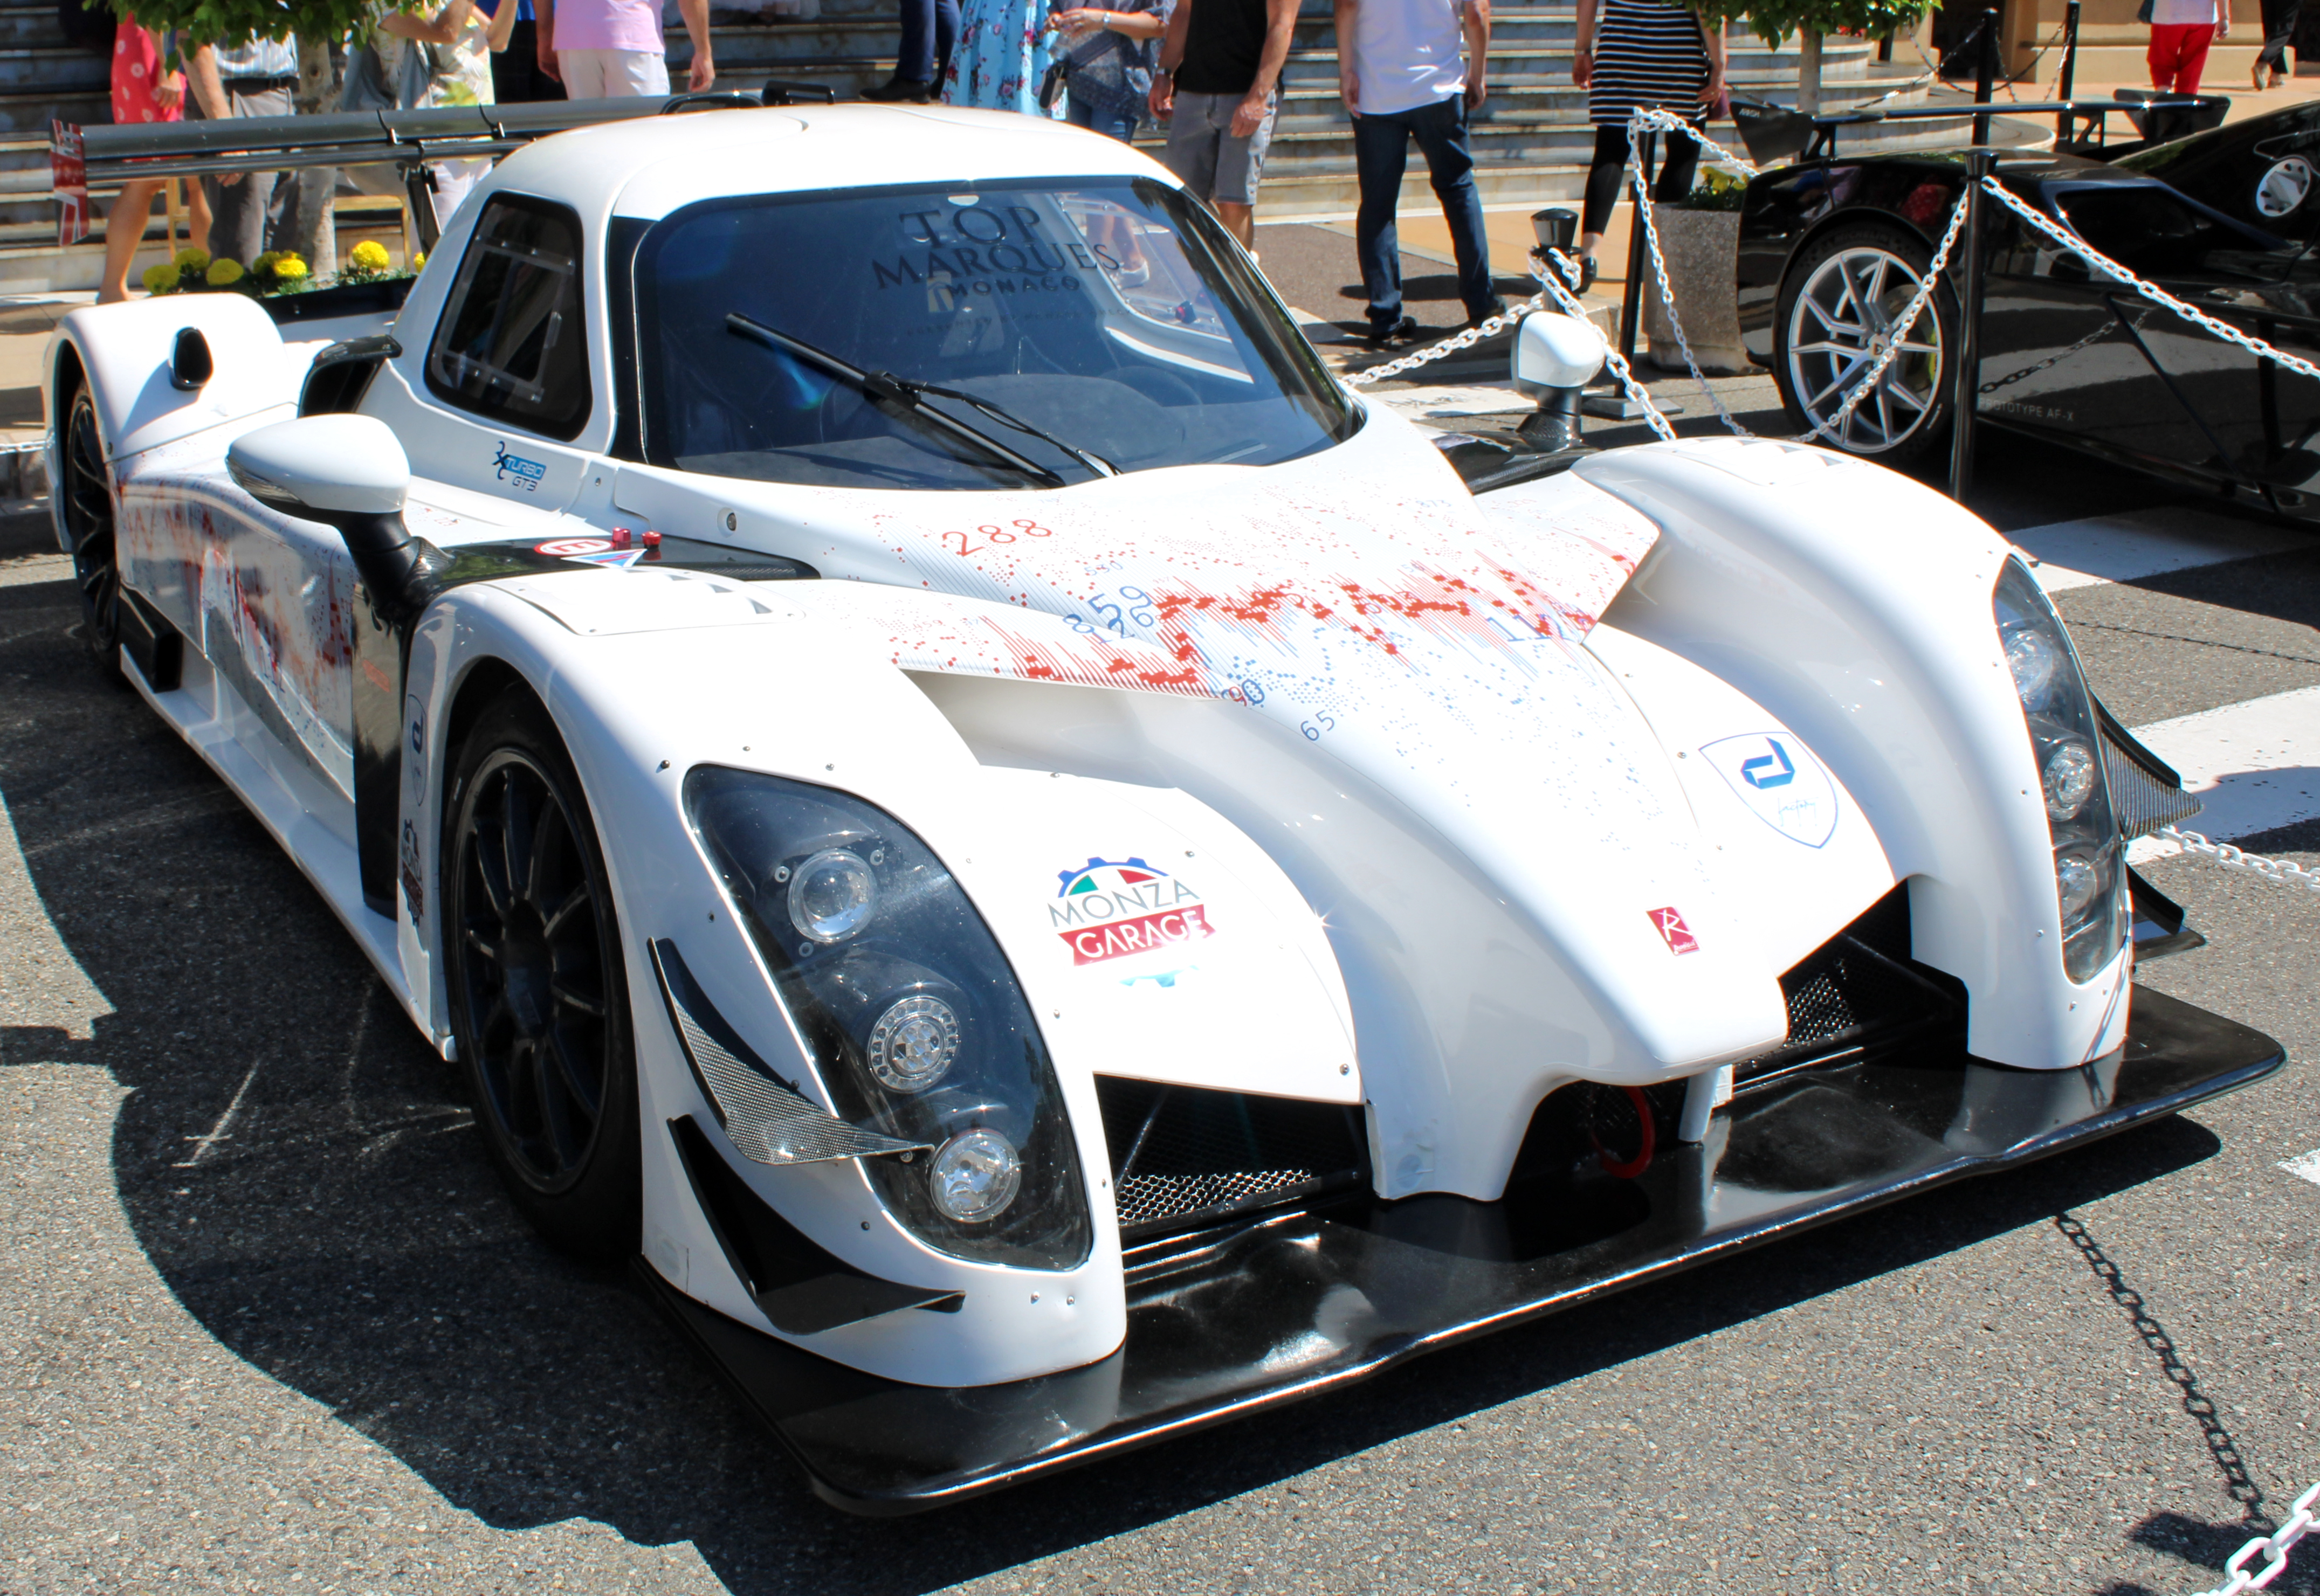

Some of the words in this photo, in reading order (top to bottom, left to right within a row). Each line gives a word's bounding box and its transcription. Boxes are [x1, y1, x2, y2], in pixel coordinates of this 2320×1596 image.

[899, 206, 1041, 248] TOP
[872, 244, 1120, 289] MARQUES
[946, 275, 1080, 298] MONACO
[1978, 398, 2042, 417] PROTOTYPE
[507, 457, 544, 478] TURBO
[512, 476, 538, 492] GT3
[942, 519, 1052, 557] 288
[1300, 709, 1334, 741] 65
[1047, 878, 1201, 927] MONZA
[1076, 910, 1208, 958] GARAGE
